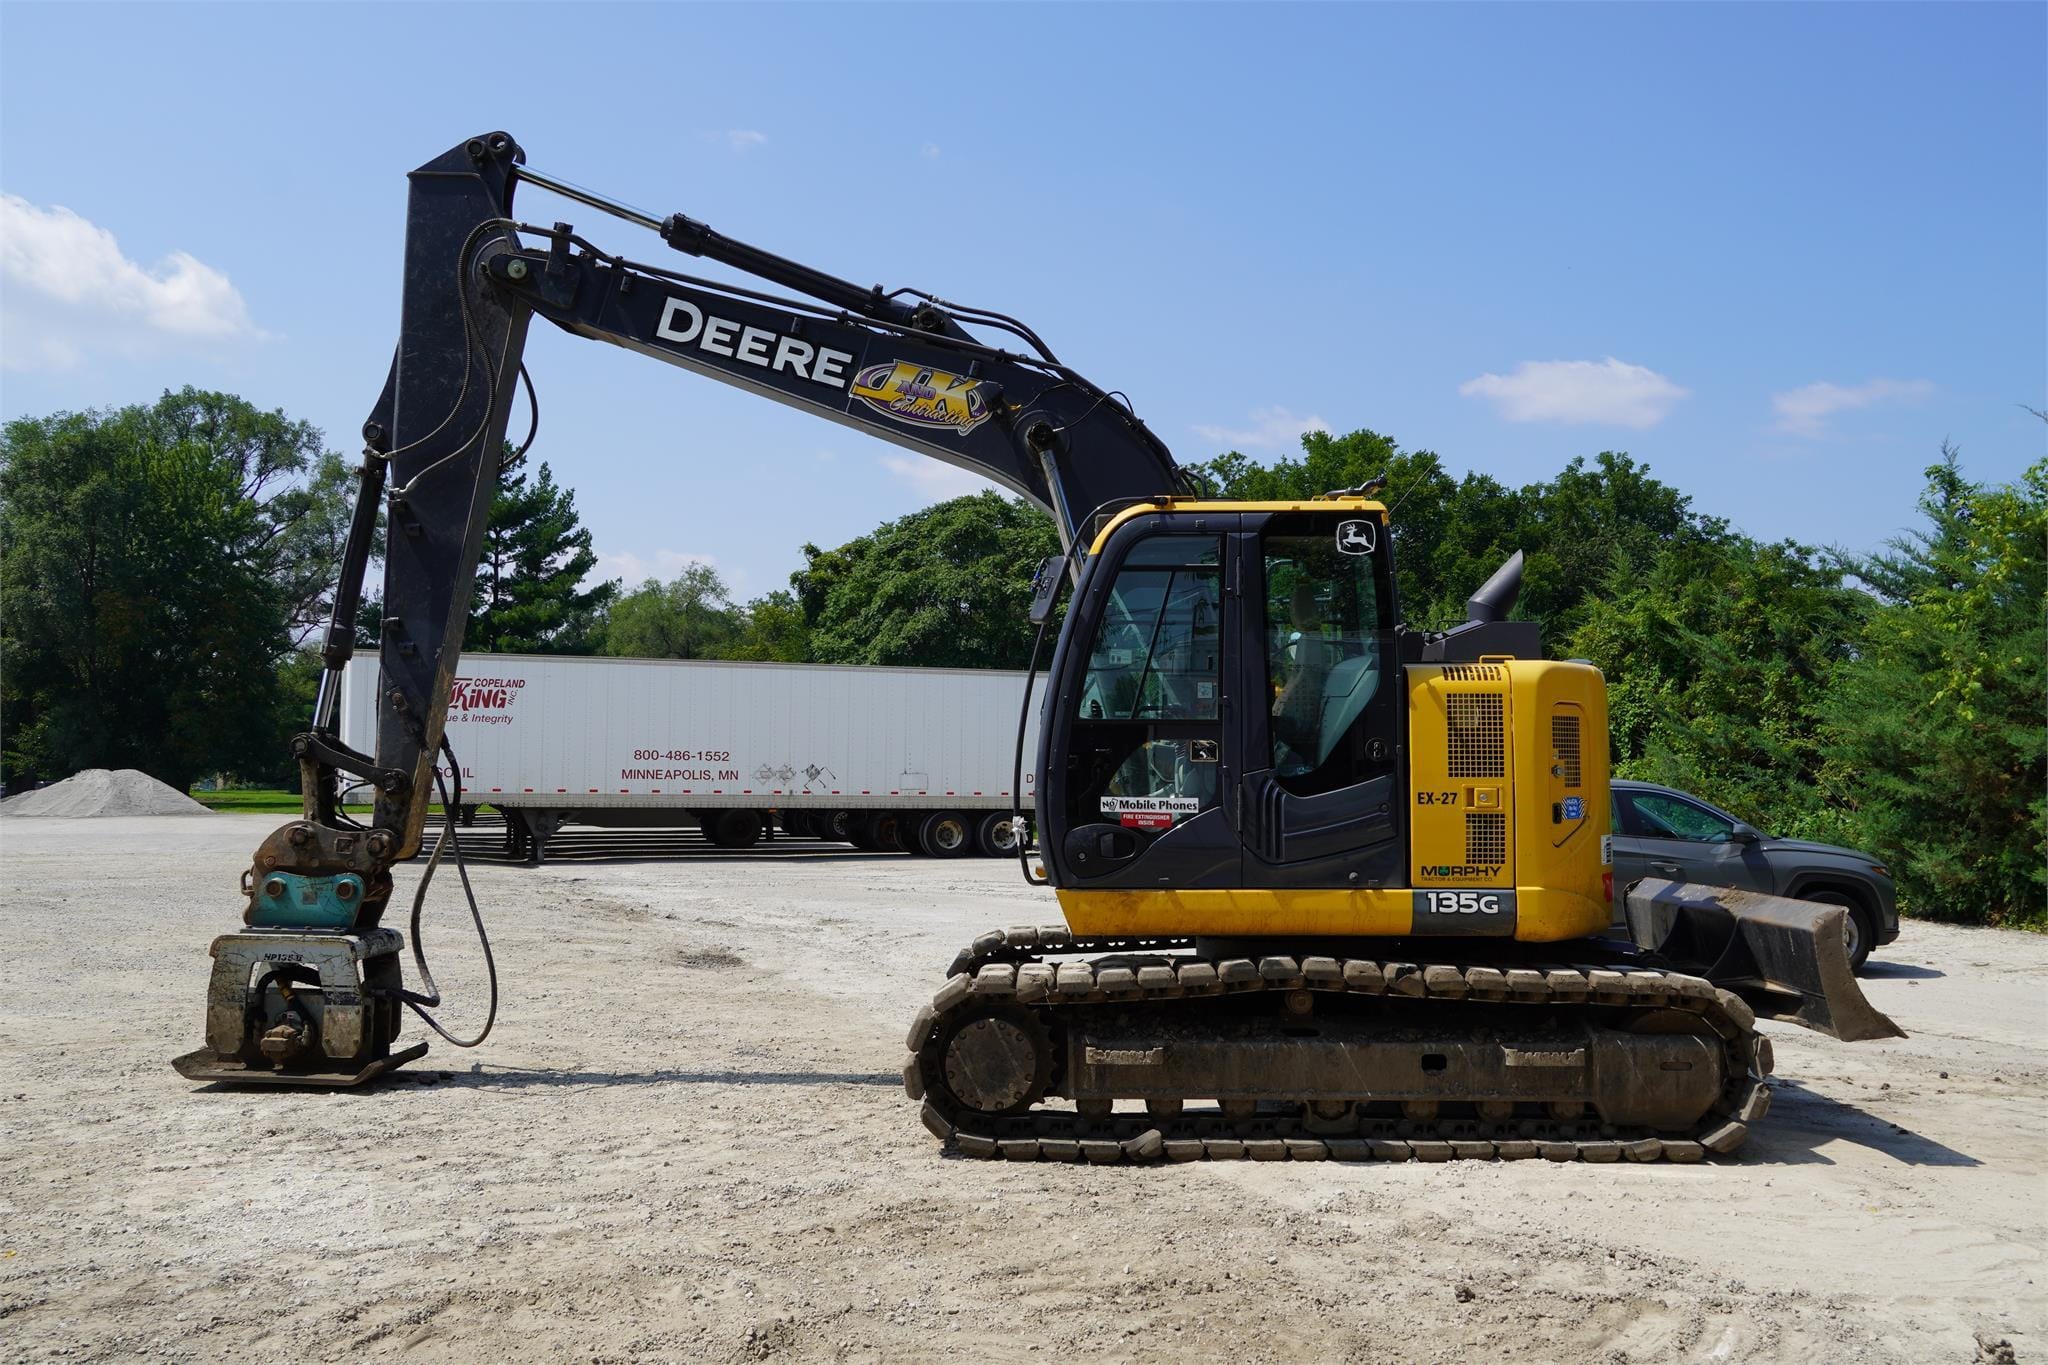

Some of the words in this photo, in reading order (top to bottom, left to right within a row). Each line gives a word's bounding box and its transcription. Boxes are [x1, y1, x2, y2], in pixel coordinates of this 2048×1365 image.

[655, 296, 853, 389] DEERE
[889, 396, 976, 428] Contracting
[474, 678, 526, 688] COPELAND
[507, 689, 519, 706] INC.
[471, 714, 514, 725] Integrity
[633, 749, 730, 762] 800-486-1552
[462, 767, 474, 778] IL
[621, 769, 714, 782] MINNEAPOLIS,
[718, 770, 739, 780] MN
[1417, 792, 1457, 805] EX-27
[1119, 800, 1156, 810] Mobile
[1158, 800, 1198, 811] Phones
[1421, 866, 1501, 876] MURPHY
[1427, 892, 1499, 914] 135G
